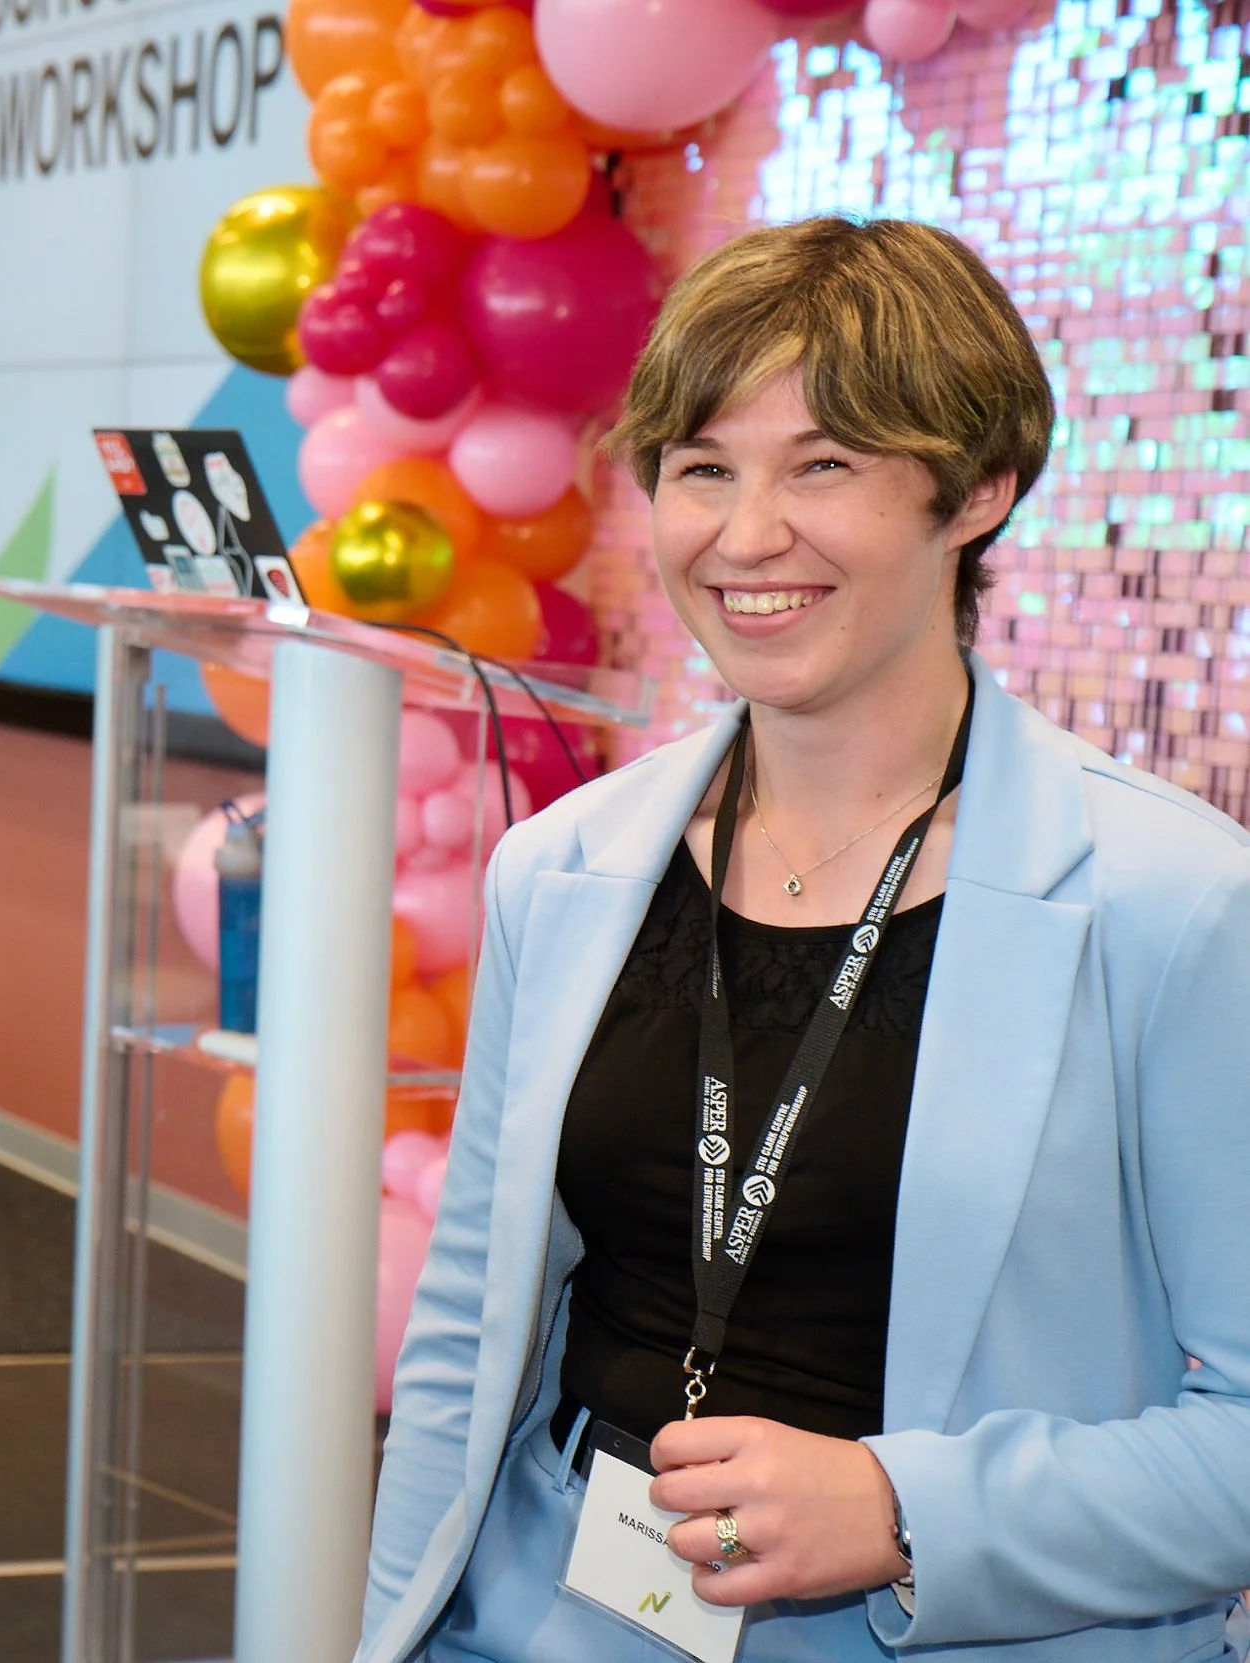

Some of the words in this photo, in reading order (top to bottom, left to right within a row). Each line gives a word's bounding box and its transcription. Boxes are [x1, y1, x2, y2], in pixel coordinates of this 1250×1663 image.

[829, 955, 865, 1009] ASPER
[710, 1076, 728, 1132] ASPER
[770, 1103, 791, 1133] CENTRE
[772, 1085, 808, 1160] ENTREPRENEURSHIP
[760, 1131, 778, 1157] CLARK
[703, 1167, 714, 1184] FOR
[715, 1168, 726, 1184] STU
[754, 1155, 768, 1172] STU
[766, 1159, 780, 1177] FOR
[714, 1184, 725, 1210] CLARK
[702, 1184, 714, 1262] ENTREPRENEURSHIP
[713, 1209, 724, 1240] CENTRE
[724, 1206, 758, 1264] ASPER
